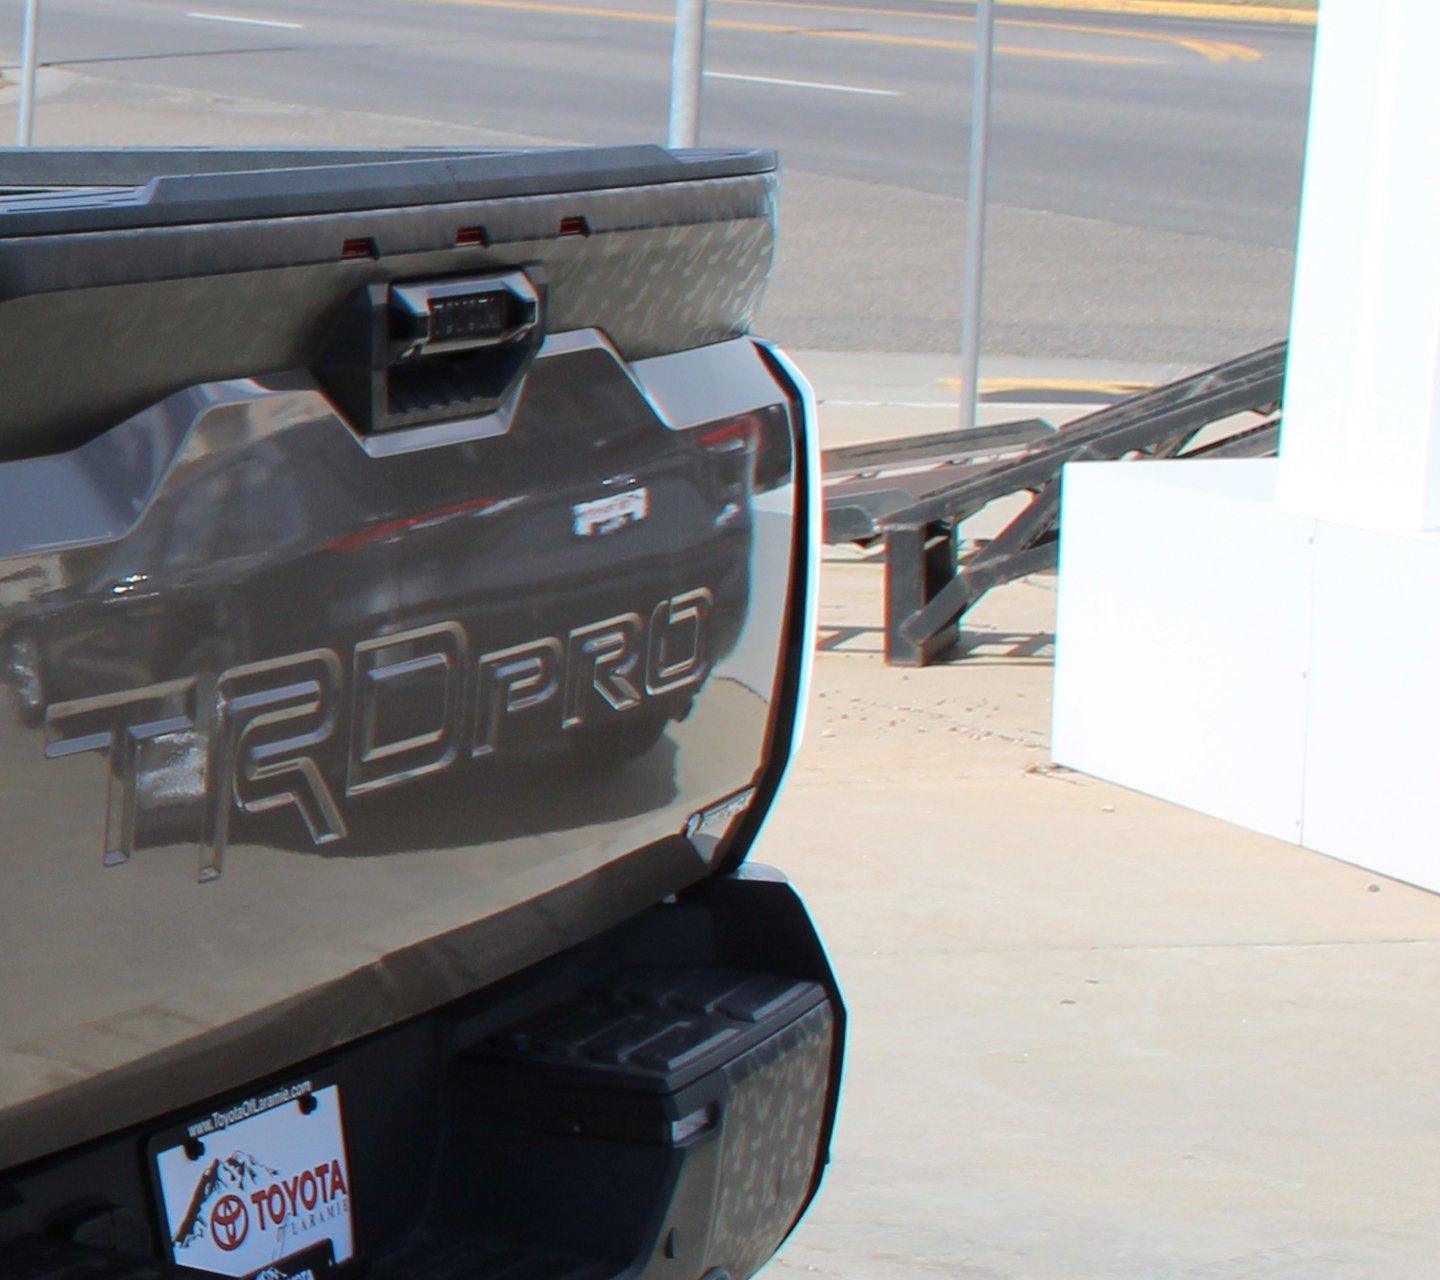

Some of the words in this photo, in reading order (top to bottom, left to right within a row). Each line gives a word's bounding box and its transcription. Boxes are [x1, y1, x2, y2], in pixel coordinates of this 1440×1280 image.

[43, 619, 468, 884] TRD
[471, 586, 715, 757] PRO
[251, 1159, 348, 1231] TOYOTA
